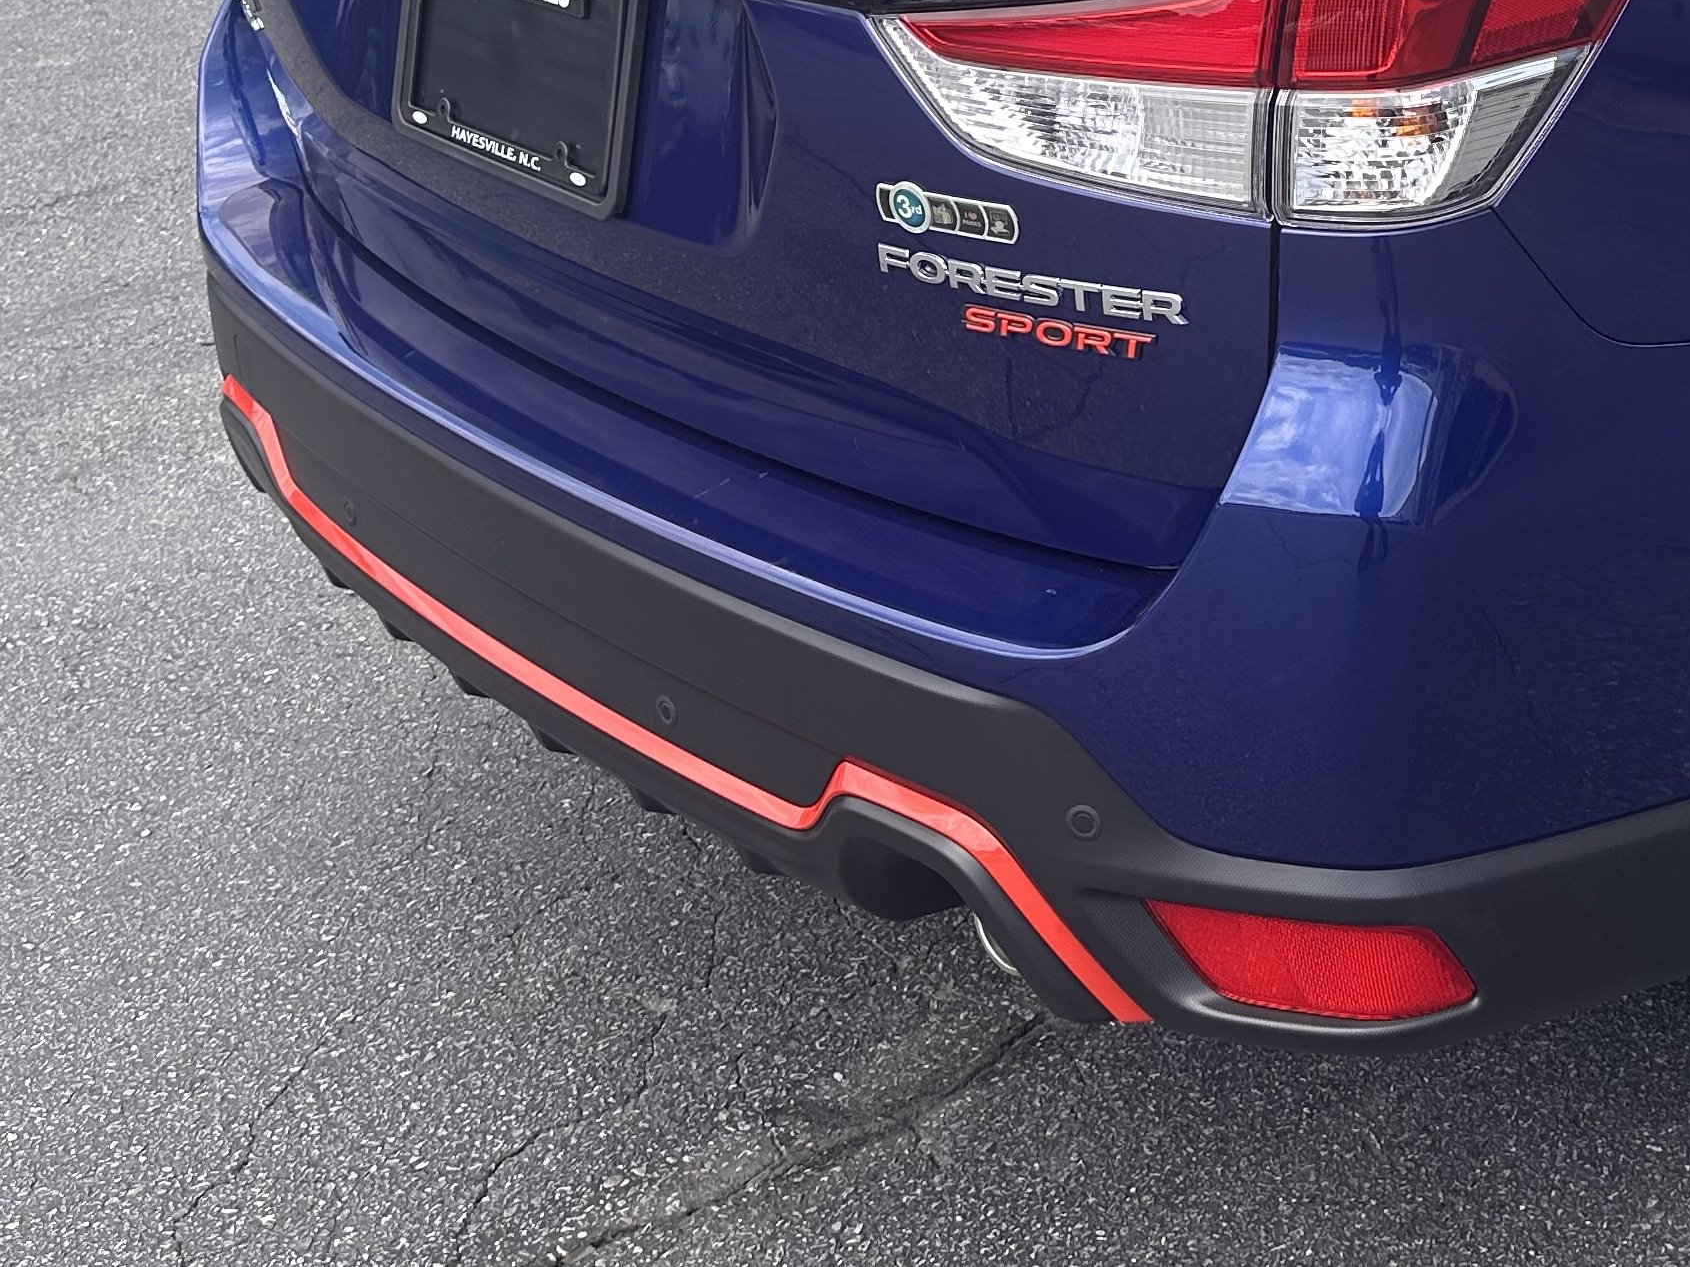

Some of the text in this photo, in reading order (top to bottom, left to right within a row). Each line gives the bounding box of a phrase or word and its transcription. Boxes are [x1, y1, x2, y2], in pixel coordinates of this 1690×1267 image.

[519, 151, 541, 172] N.C.
[896, 194, 923, 219] 3rd
[877, 243, 1189, 325] FORESTER
[962, 303, 1156, 360] SPORT
